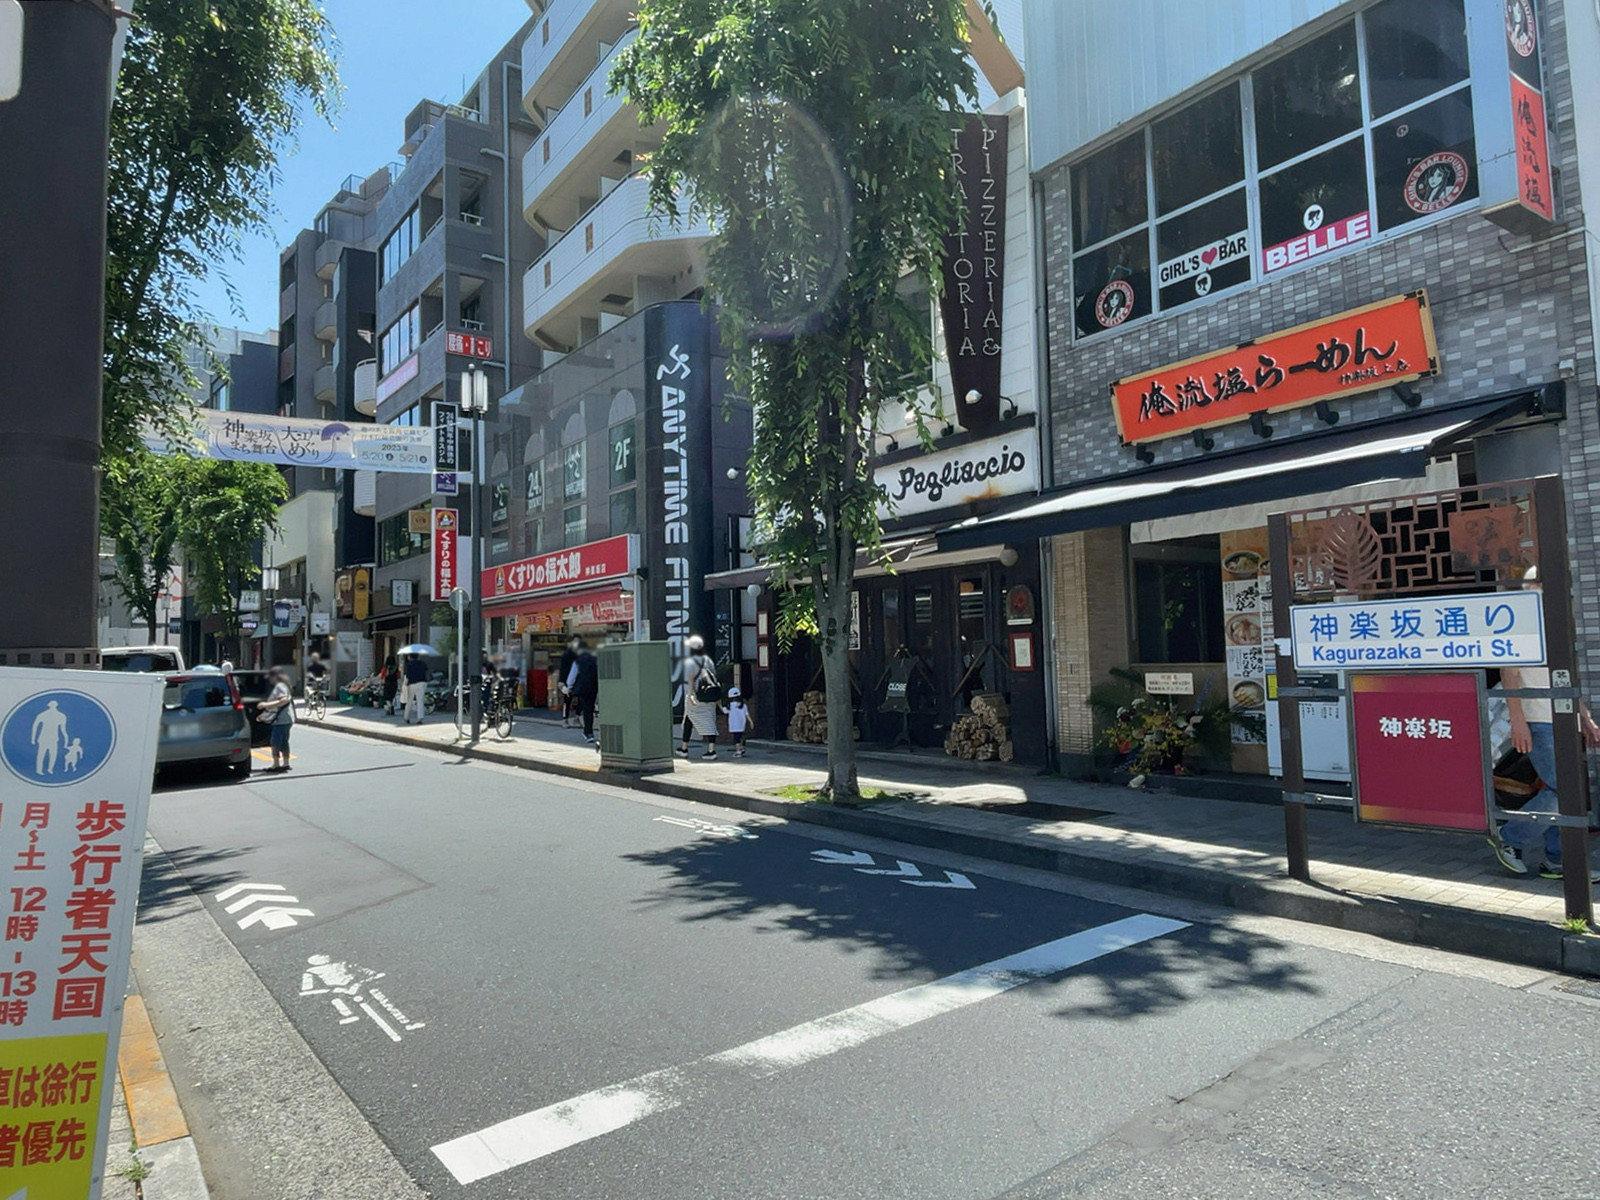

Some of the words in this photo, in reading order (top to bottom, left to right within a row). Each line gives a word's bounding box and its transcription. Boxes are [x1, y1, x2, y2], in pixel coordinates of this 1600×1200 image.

[981, 128, 1000, 328] PIZZERIA
[1266, 213, 1370, 272] BELLE
[1159, 247, 1201, 284] GIRL'S
[1217, 234, 1248, 263] BAR
[1138, 327, 1399, 423] 俺流塩らーめん
[615, 437, 631, 472] 2F
[661, 385, 689, 545] ANYTIME
[891, 444, 1026, 502] Pagliaccio
[507, 551, 581, 590] くすりの福太郎
[1309, 604, 1517, 642] 神楽坂通り
[1491, 638, 1521, 658] St.
[1379, 716, 1453, 740] 神楽坂
[52, 799, 127, 1021] 歩行者天国
